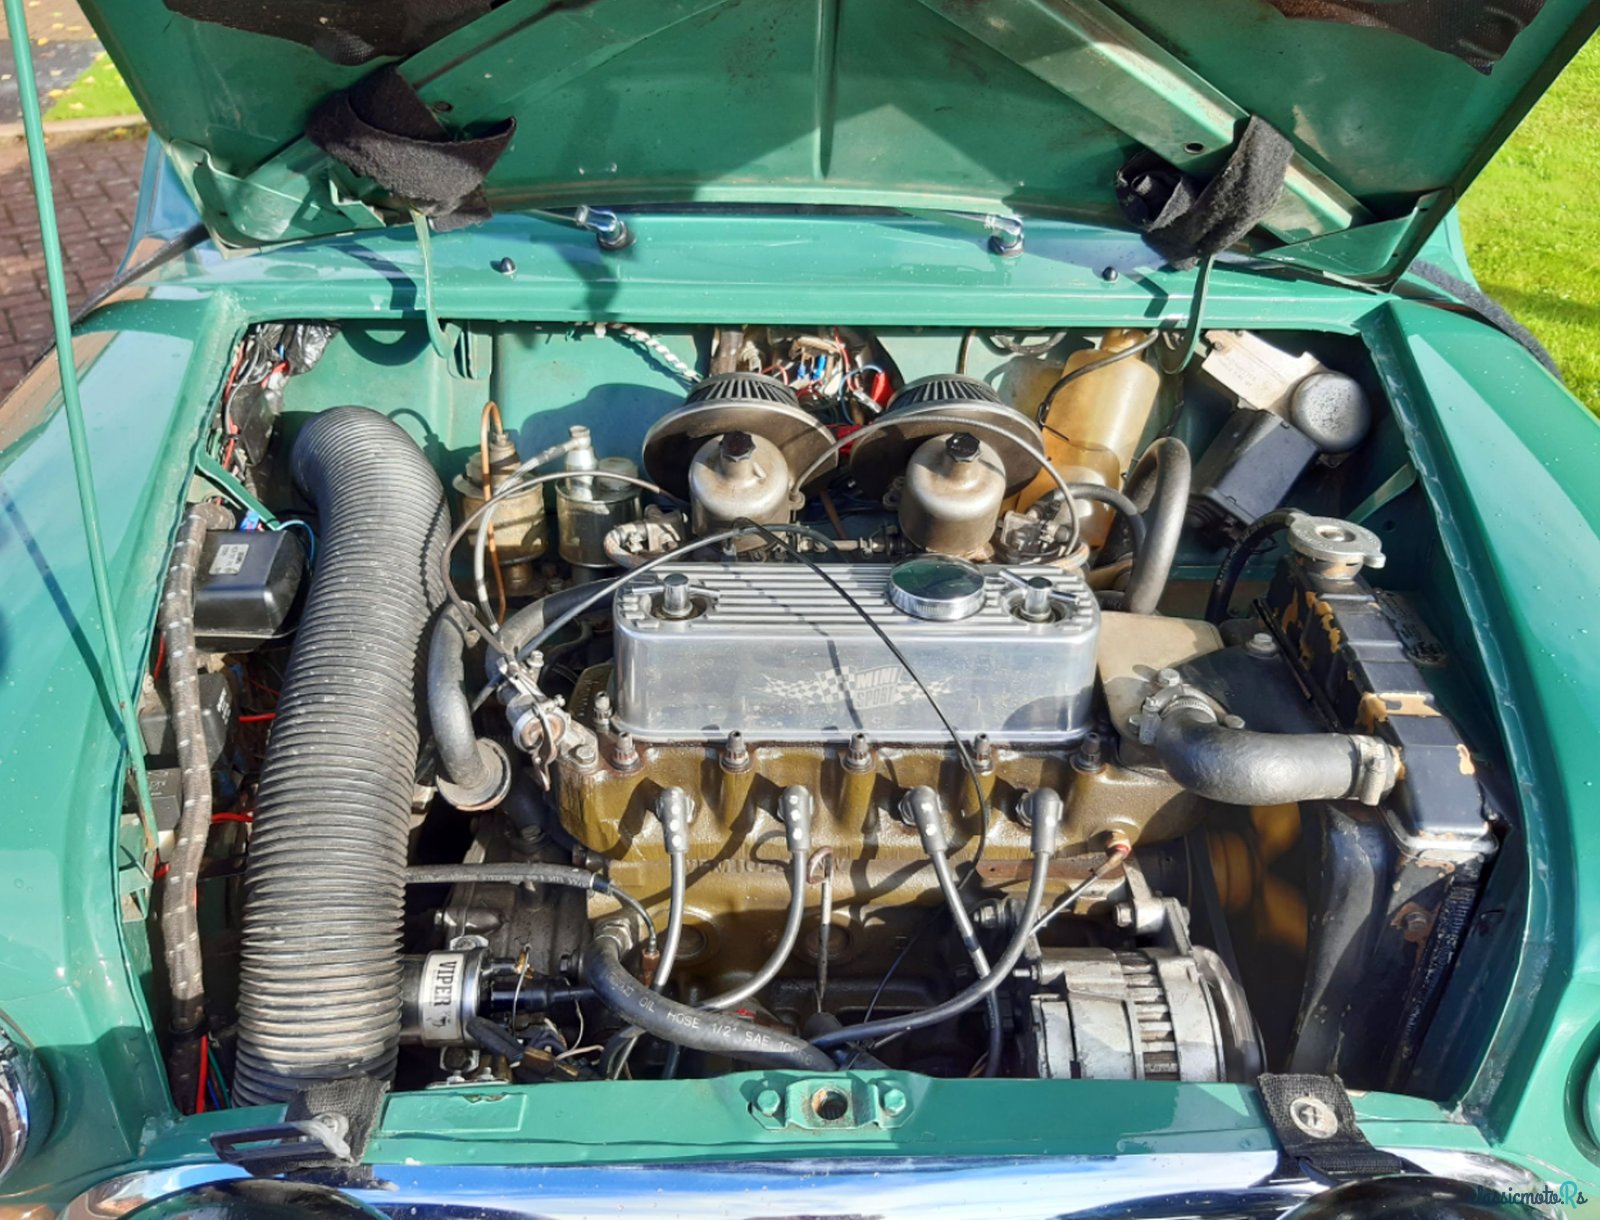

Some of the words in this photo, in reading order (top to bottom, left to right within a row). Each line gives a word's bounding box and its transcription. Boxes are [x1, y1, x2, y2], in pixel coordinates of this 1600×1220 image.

[855, 667, 898, 689] MINI
[856, 686, 894, 708] SPORT
[433, 961, 457, 1007] VIPER
[639, 996, 655, 1013] OIL
[667, 1010, 700, 1029] HOSE
[745, 1031, 770, 1048] SAE
